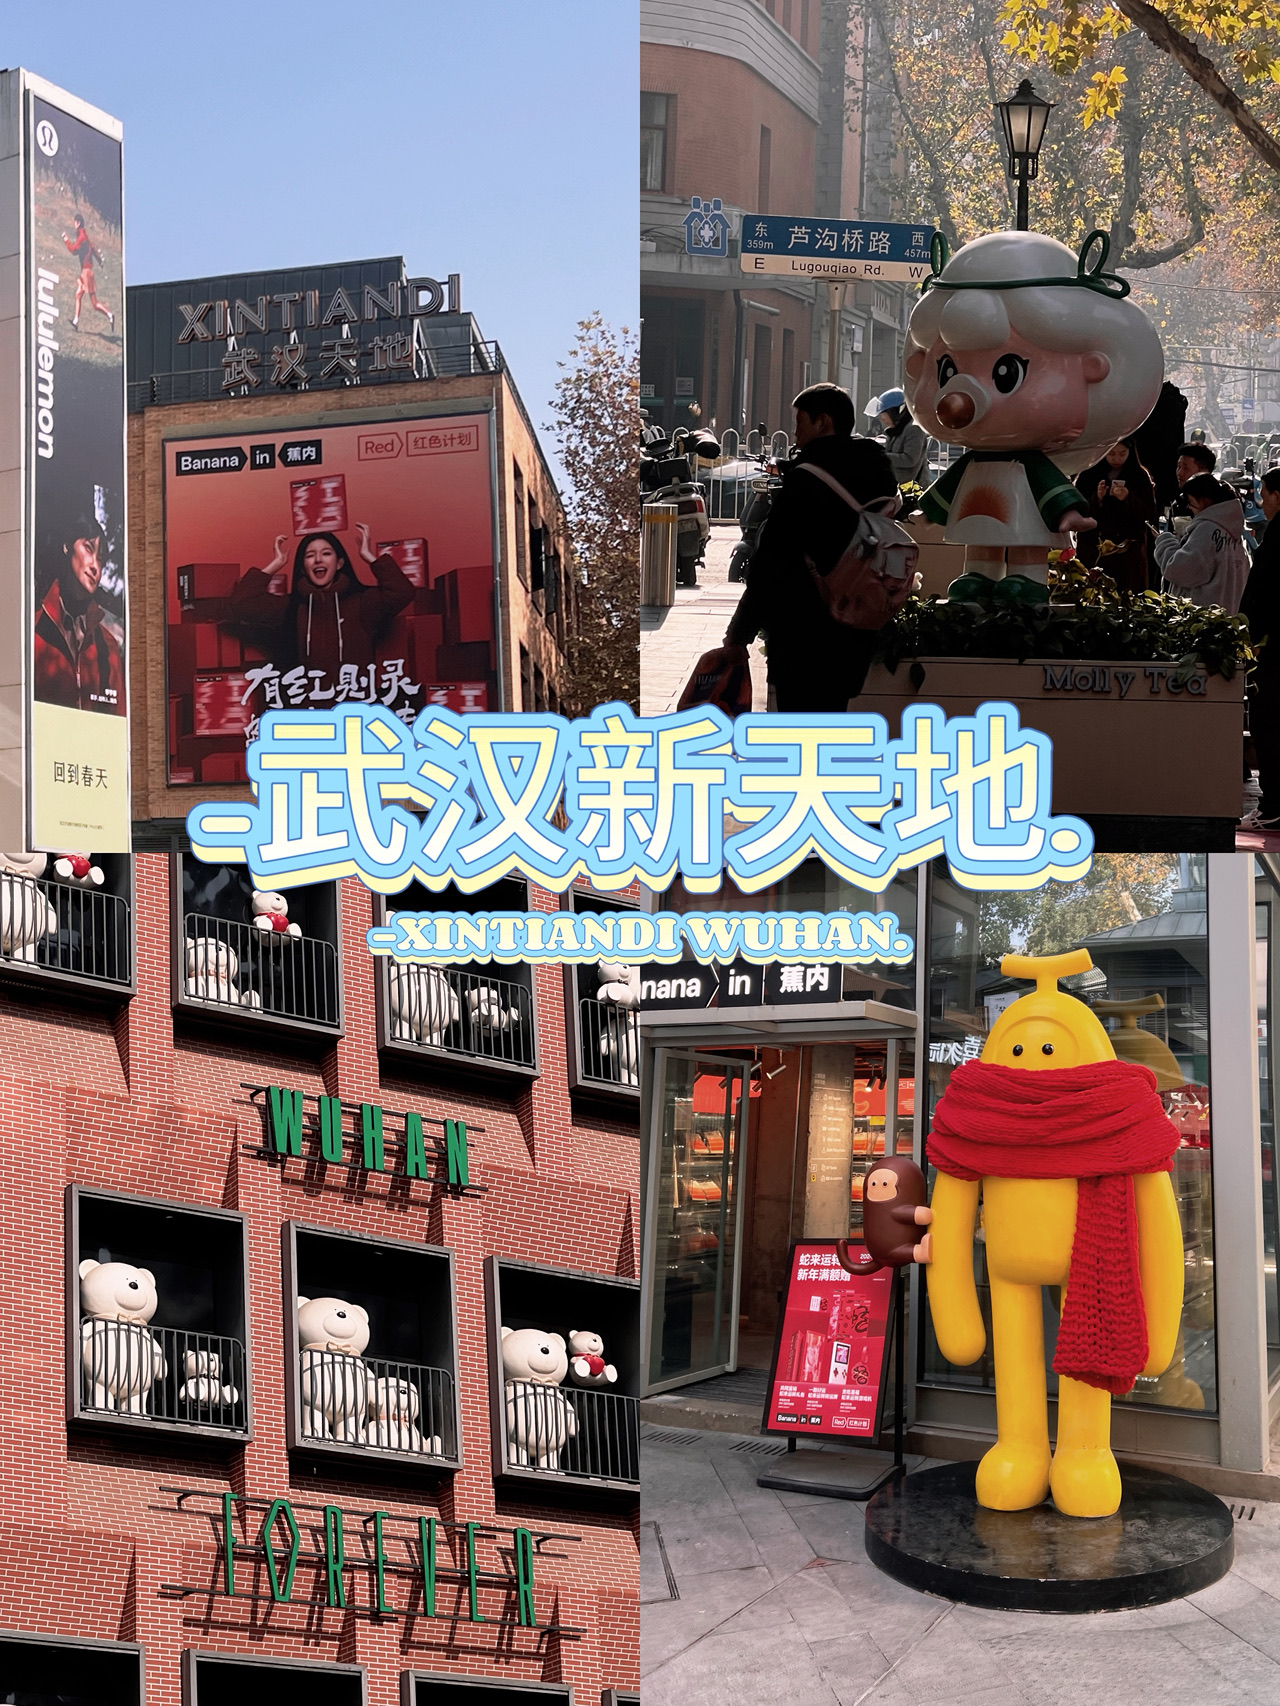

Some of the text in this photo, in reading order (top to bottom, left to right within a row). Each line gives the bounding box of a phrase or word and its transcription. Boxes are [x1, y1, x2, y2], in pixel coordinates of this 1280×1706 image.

[747, 239, 931, 260] 359m 457m
[754, 221, 925, 255] 东 芦沟桥路 西
[754, 257, 924, 279] E Lugouqiao Rd. W
[176, 273, 462, 344] XINTIANDI
[37, 267, 60, 459] lululemon
[220, 331, 414, 391] 武汉天地
[181, 445, 317, 471] Banana in 蕉内
[365, 432, 472, 455] Red 红色计划
[1043, 665, 1207, 697] Molly Tea
[53, 760, 108, 789] 回到春天
[728, 969, 751, 996] in
[779, 964, 829, 995] 蕉内
[267, 1085, 470, 1186] WUHAN
[223, 1492, 537, 1627] FOREVER
